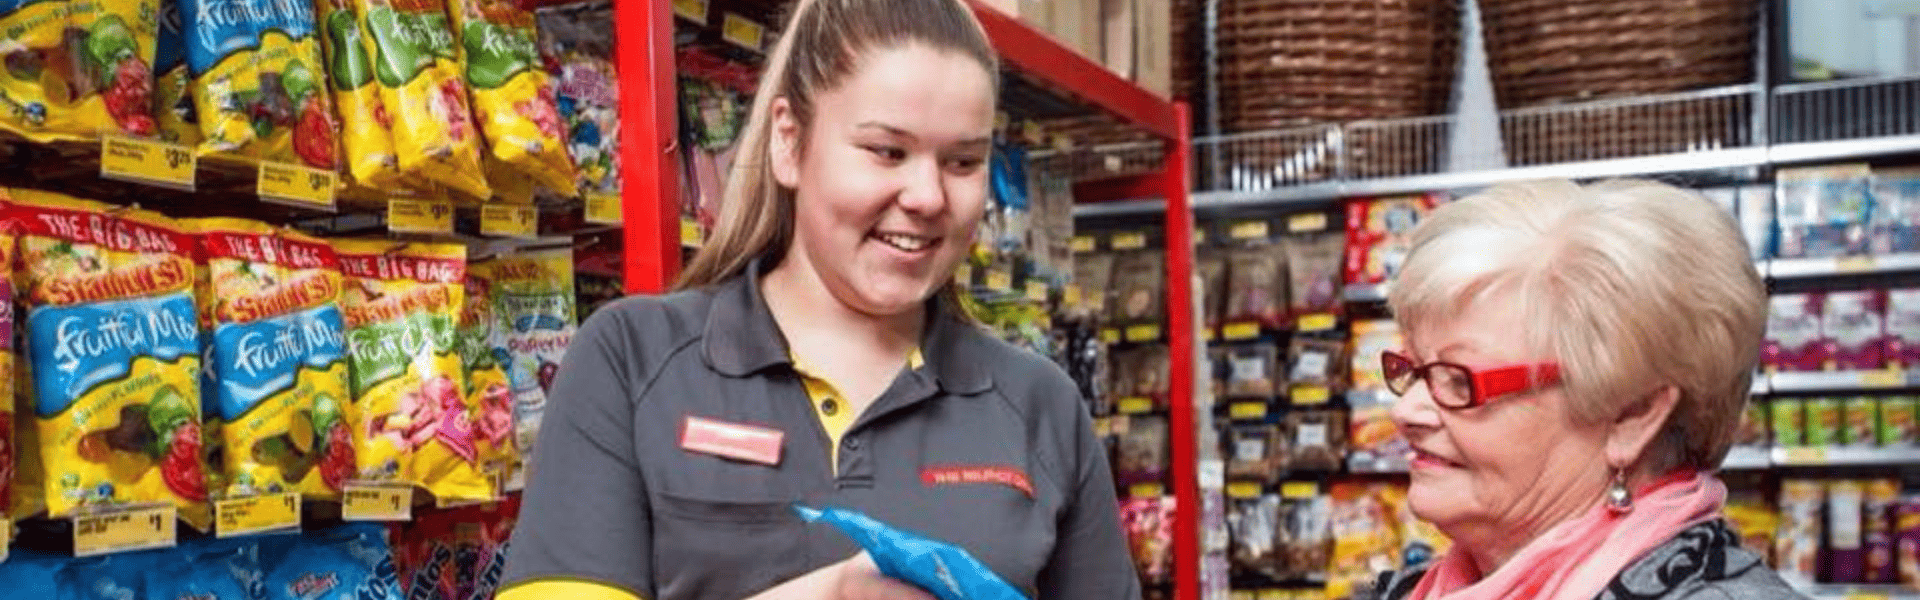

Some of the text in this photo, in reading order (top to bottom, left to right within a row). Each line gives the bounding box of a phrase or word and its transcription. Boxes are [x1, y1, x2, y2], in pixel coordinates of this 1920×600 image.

[37, 213, 177, 252] THE BIG BAG
[225, 235, 260, 260] THE
[290, 244, 323, 267] BAG
[339, 255, 453, 282] THE BIG BAG
